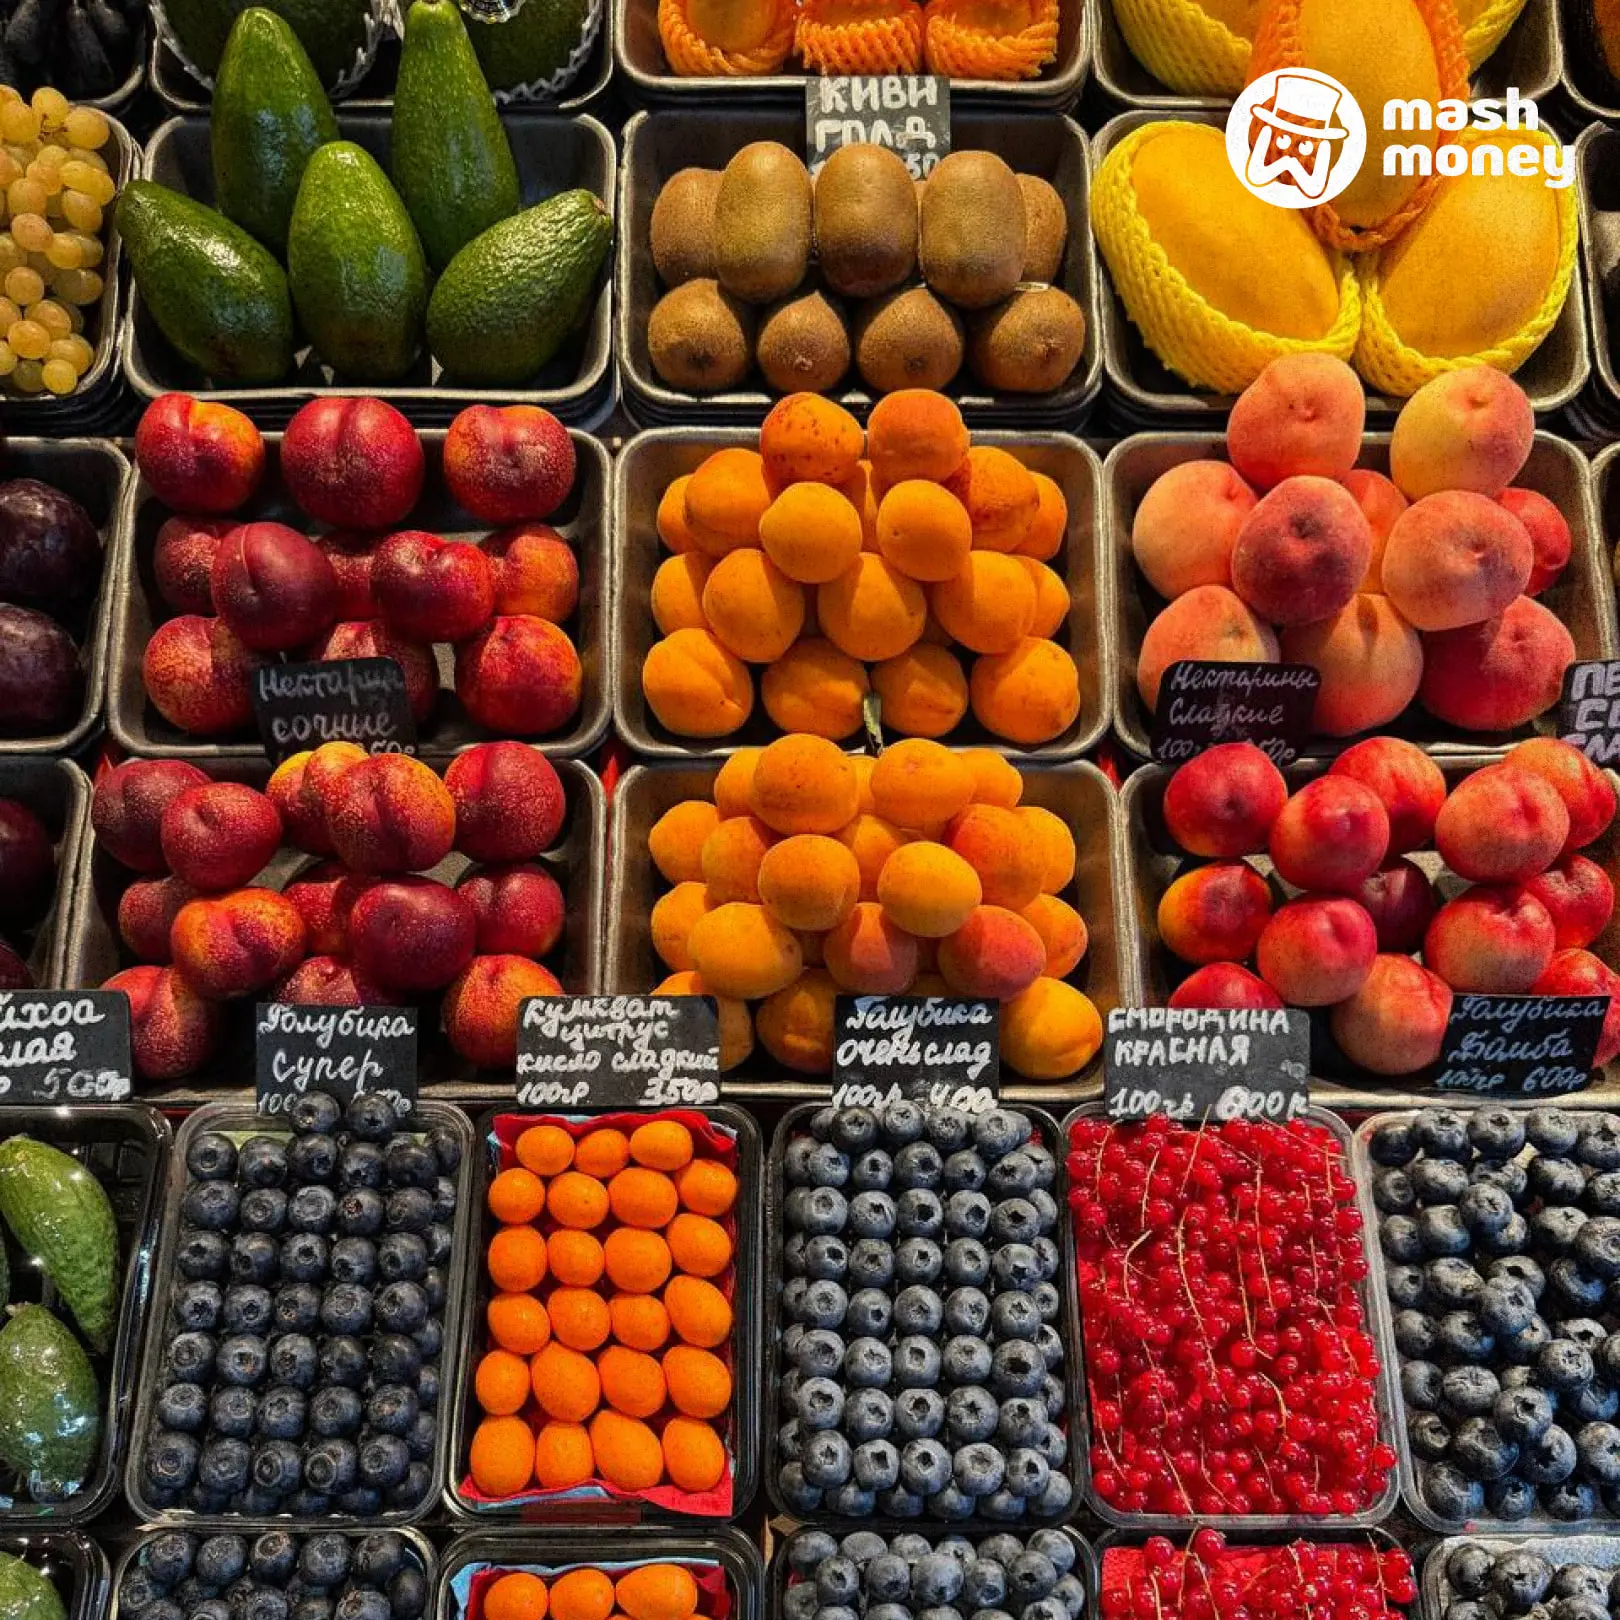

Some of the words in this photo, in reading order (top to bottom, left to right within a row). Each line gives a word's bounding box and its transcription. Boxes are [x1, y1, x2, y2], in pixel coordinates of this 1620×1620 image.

[819, 76, 938, 113] КИВИ
[1108, 1008, 1290, 1035] СМОРОДИНА
[1115, 1035, 1250, 1067] КРАСНАЯ
[272, 1050, 384, 1092] Супер
